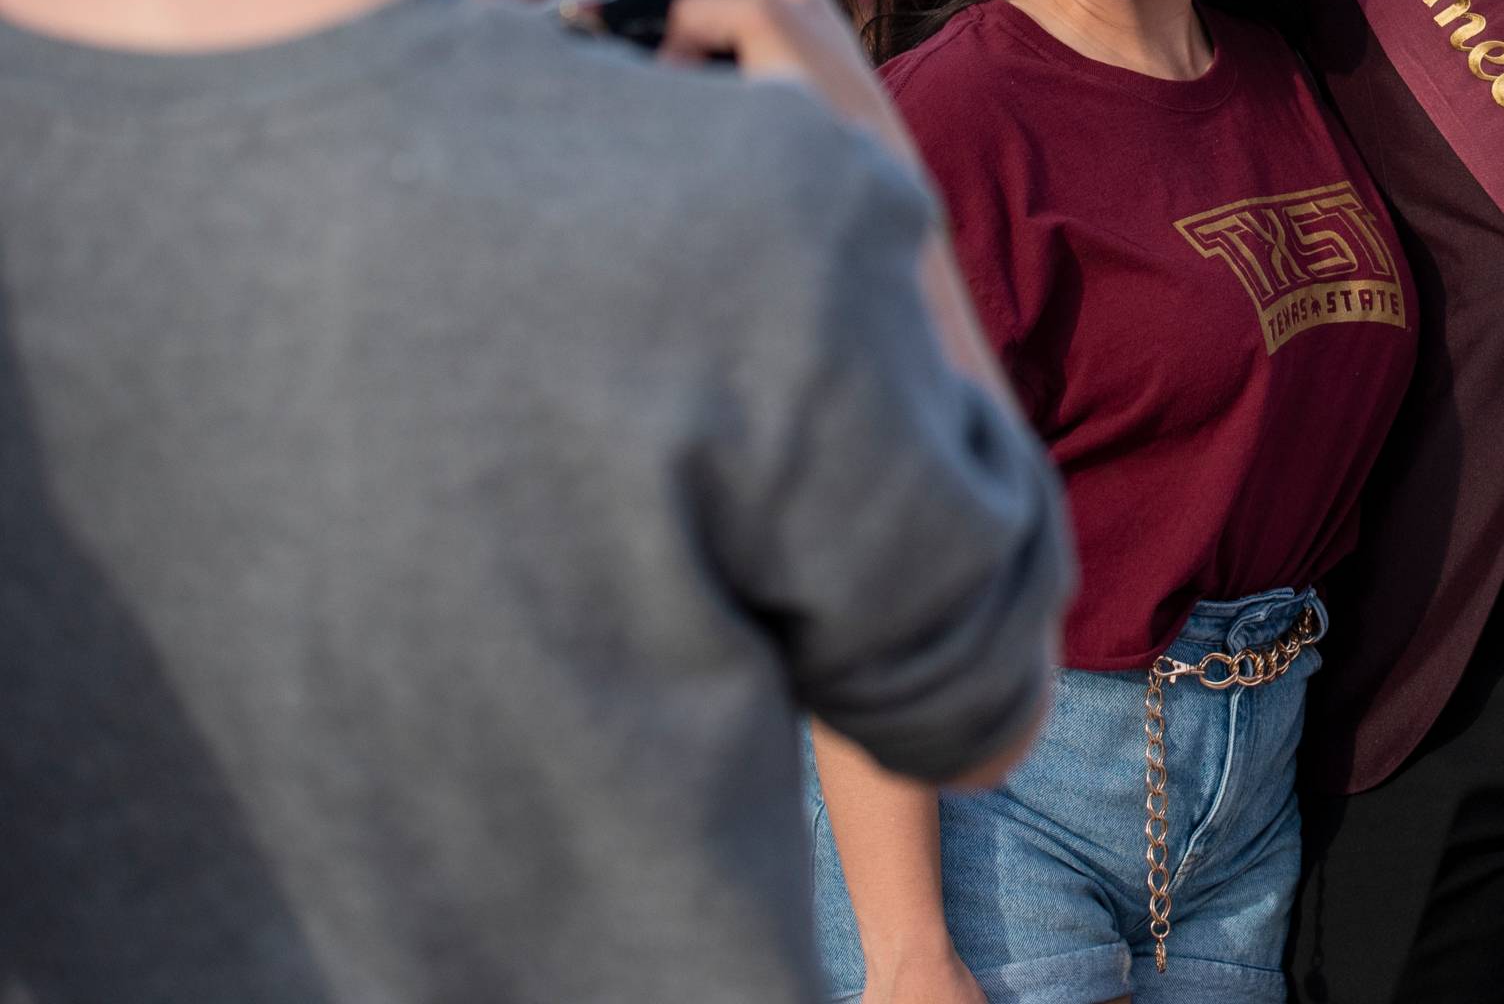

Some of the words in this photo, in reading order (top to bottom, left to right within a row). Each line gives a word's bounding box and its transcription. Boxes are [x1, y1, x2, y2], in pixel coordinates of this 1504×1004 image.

[1190, 191, 1392, 302] TXST
[1267, 297, 1308, 342] TEXAS
[1326, 288, 1400, 316] STATE
